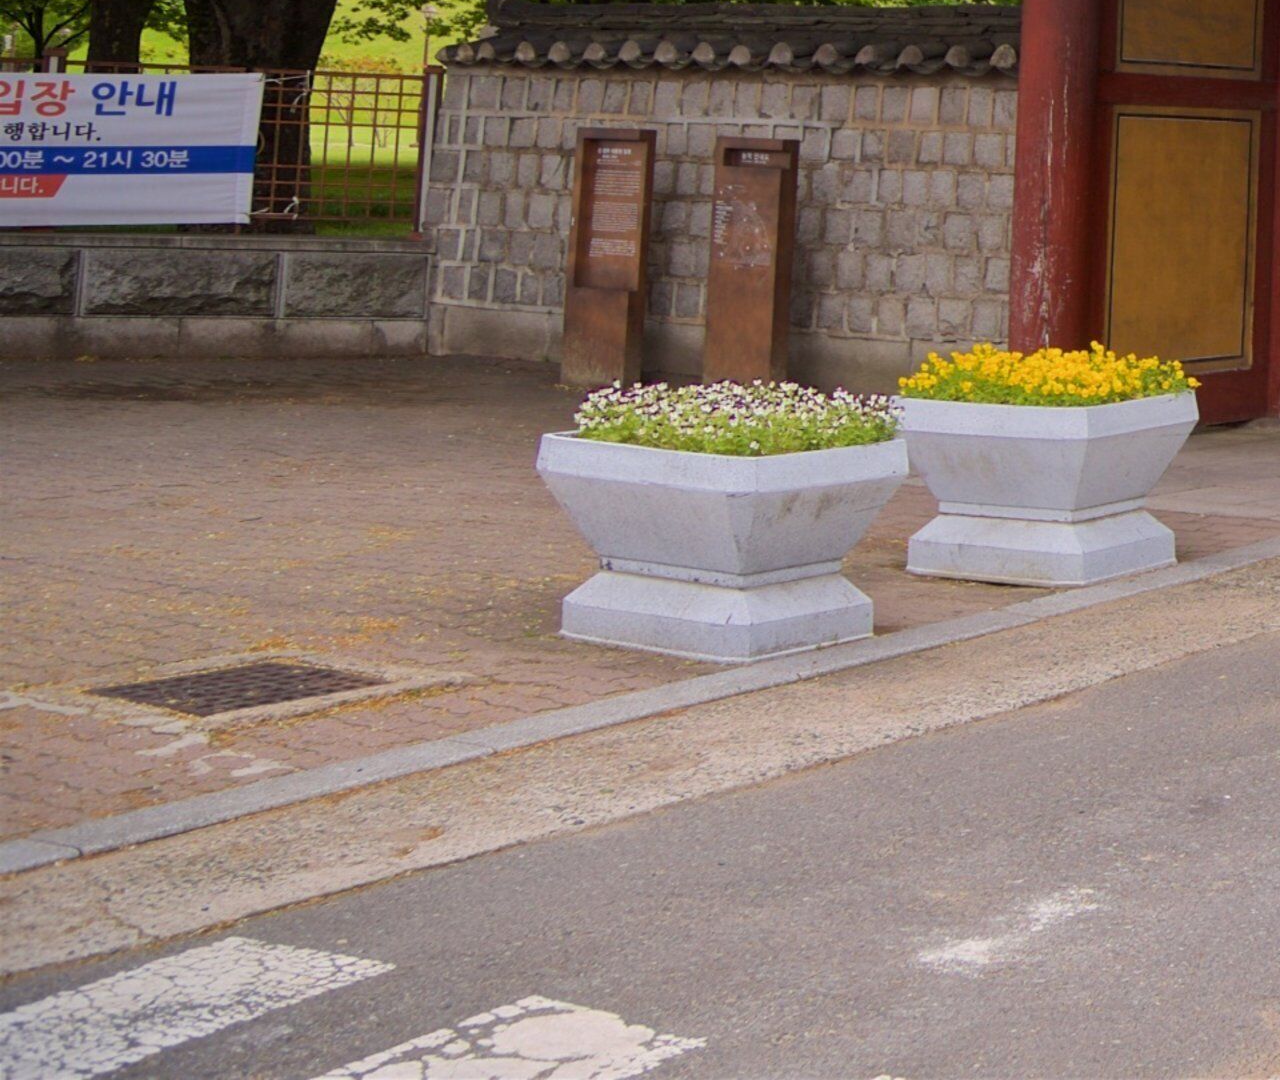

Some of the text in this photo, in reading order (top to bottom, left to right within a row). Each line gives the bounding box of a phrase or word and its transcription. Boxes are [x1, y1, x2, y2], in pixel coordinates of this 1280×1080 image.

[92, 81, 177, 116] 안내
[4, 122, 102, 141] 행합니다.
[83, 150, 132, 169] 21시
[140, 150, 190, 169] 30분
[0, 177, 44, 194] 니다.
